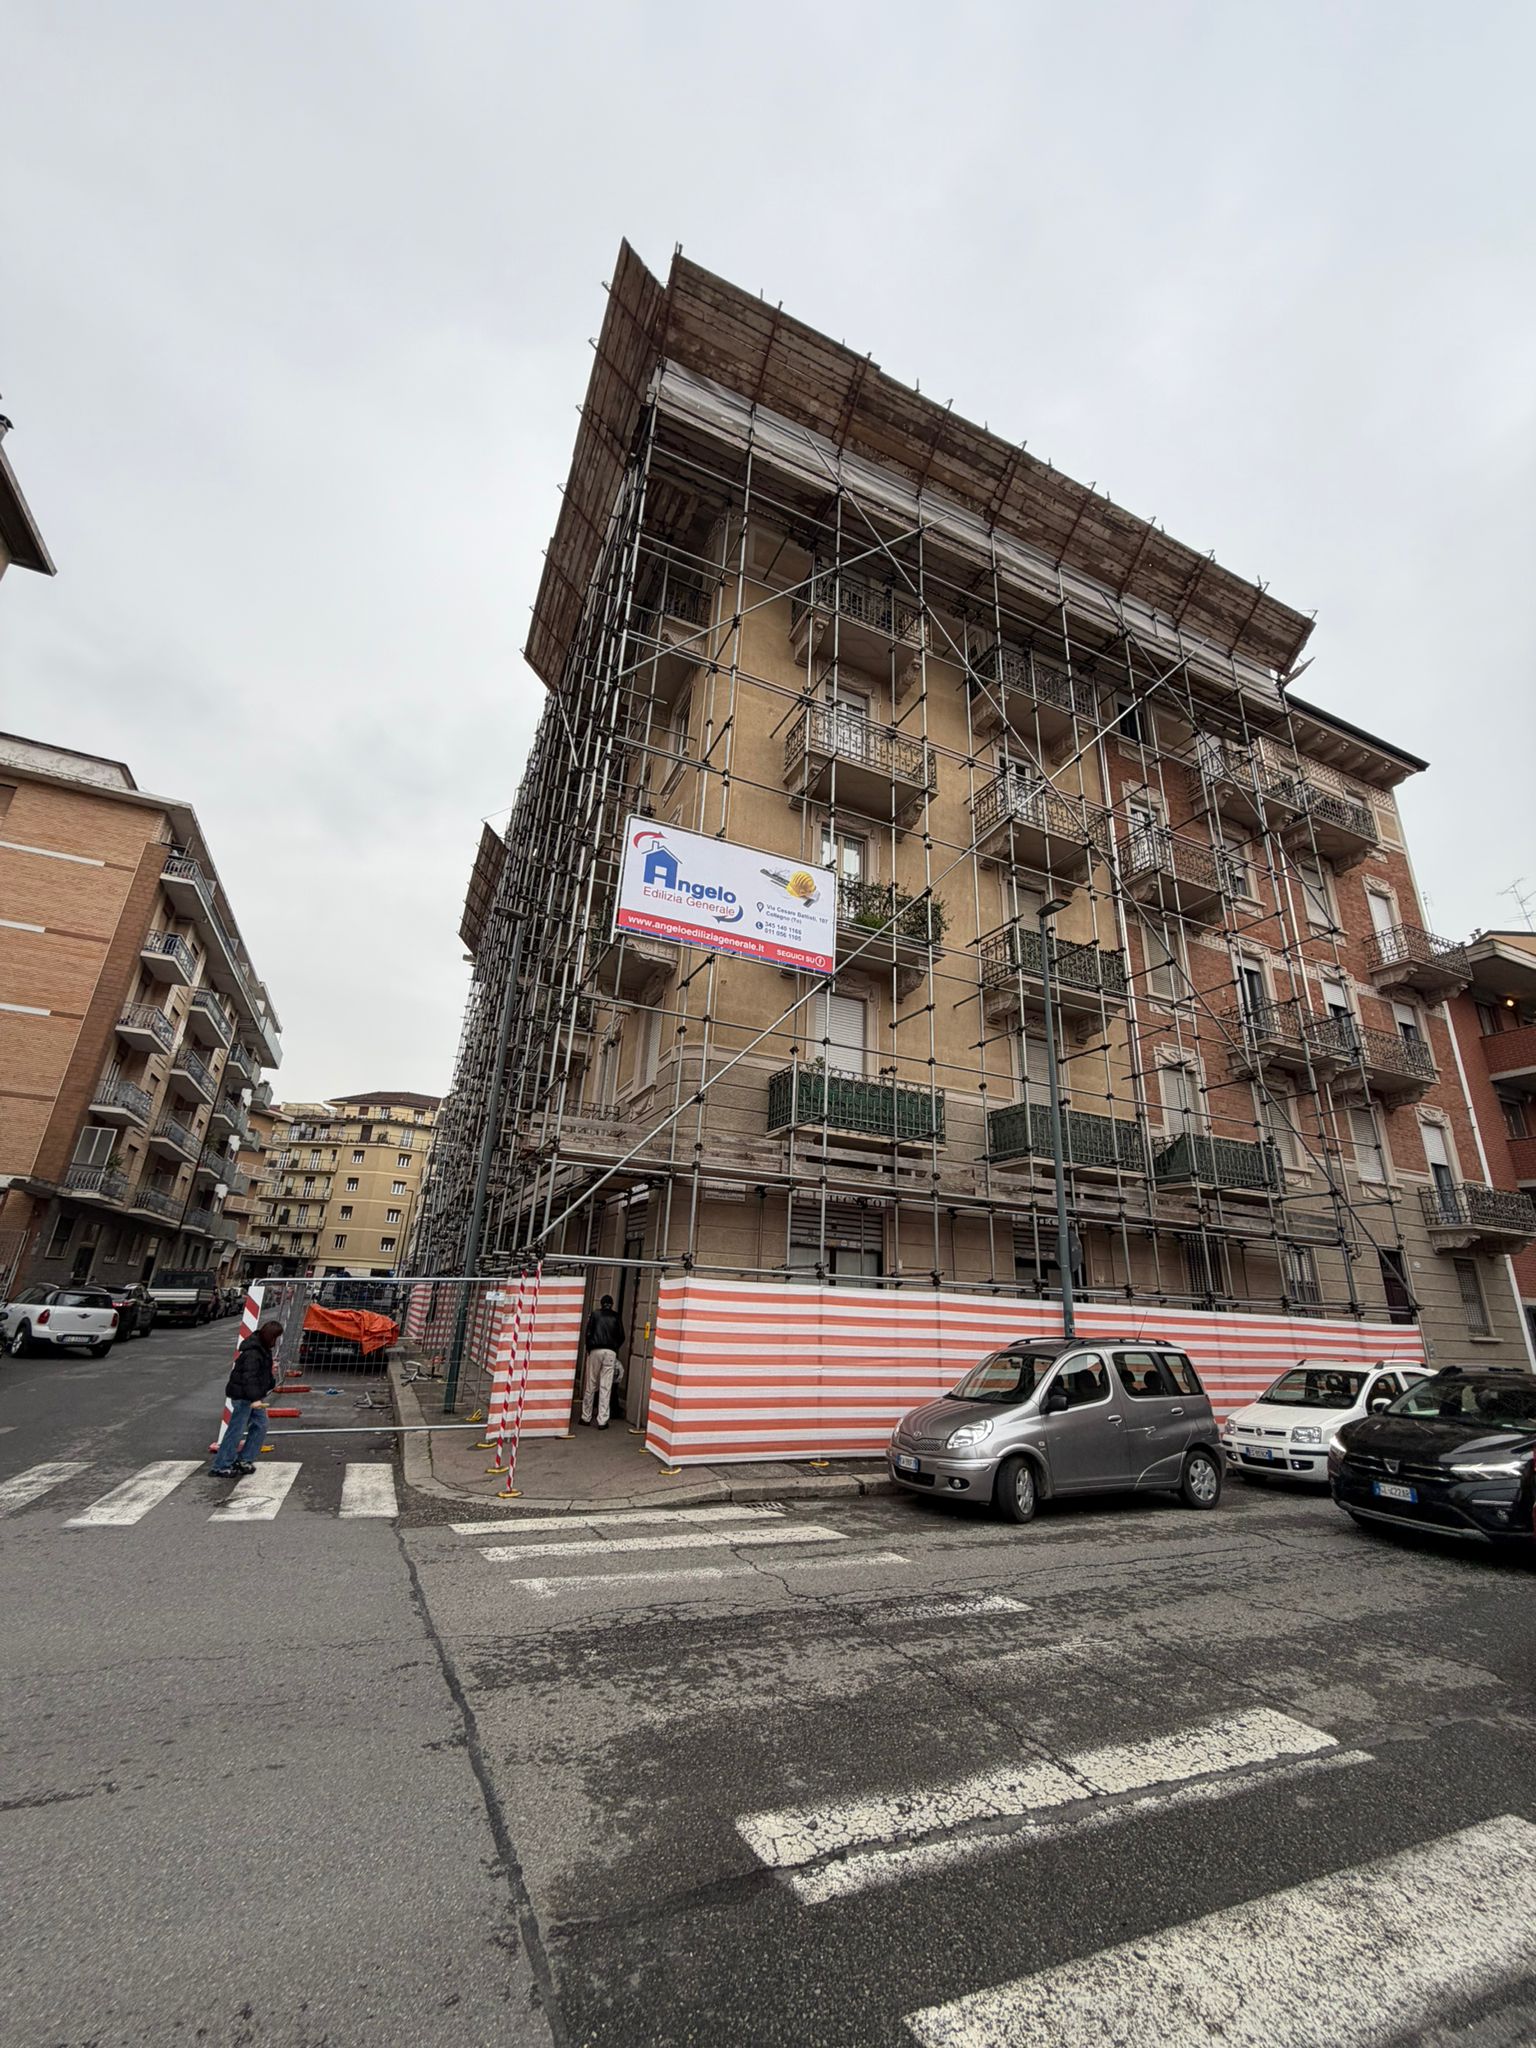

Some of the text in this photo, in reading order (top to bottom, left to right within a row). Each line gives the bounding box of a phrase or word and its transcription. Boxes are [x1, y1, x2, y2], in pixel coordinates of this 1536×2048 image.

[643, 849, 737, 904] Angelo
[643, 886, 736, 916] Edilizia Generale
[627, 915, 766, 953] www.angeloediliziagenerale.it
[776, 949, 815, 964] SEGUICI SU
